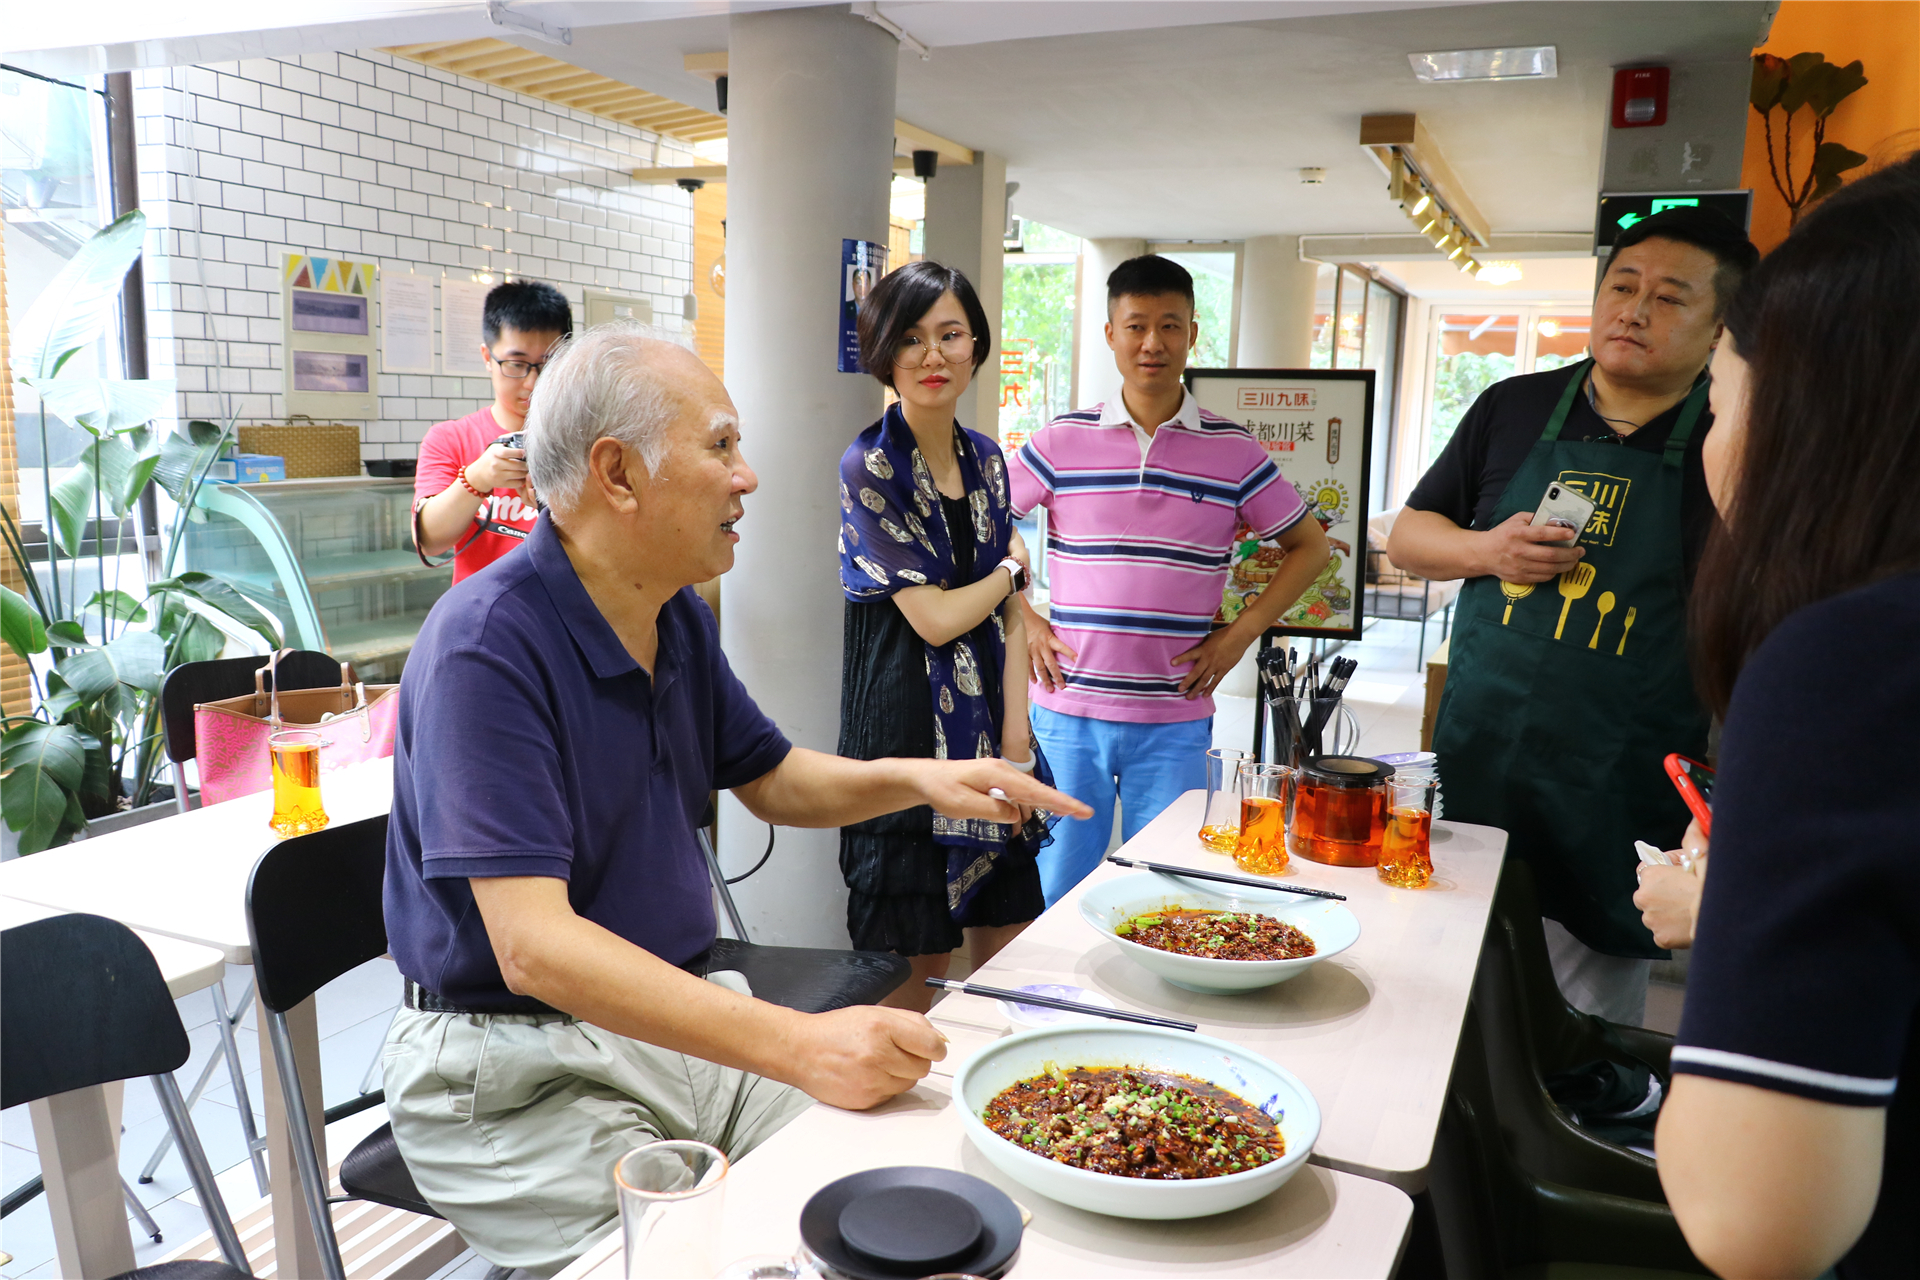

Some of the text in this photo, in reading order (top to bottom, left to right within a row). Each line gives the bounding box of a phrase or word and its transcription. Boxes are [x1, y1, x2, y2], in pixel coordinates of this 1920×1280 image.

[1243, 392, 1310, 407] 三川九味
[497, 526, 528, 538] Cano
